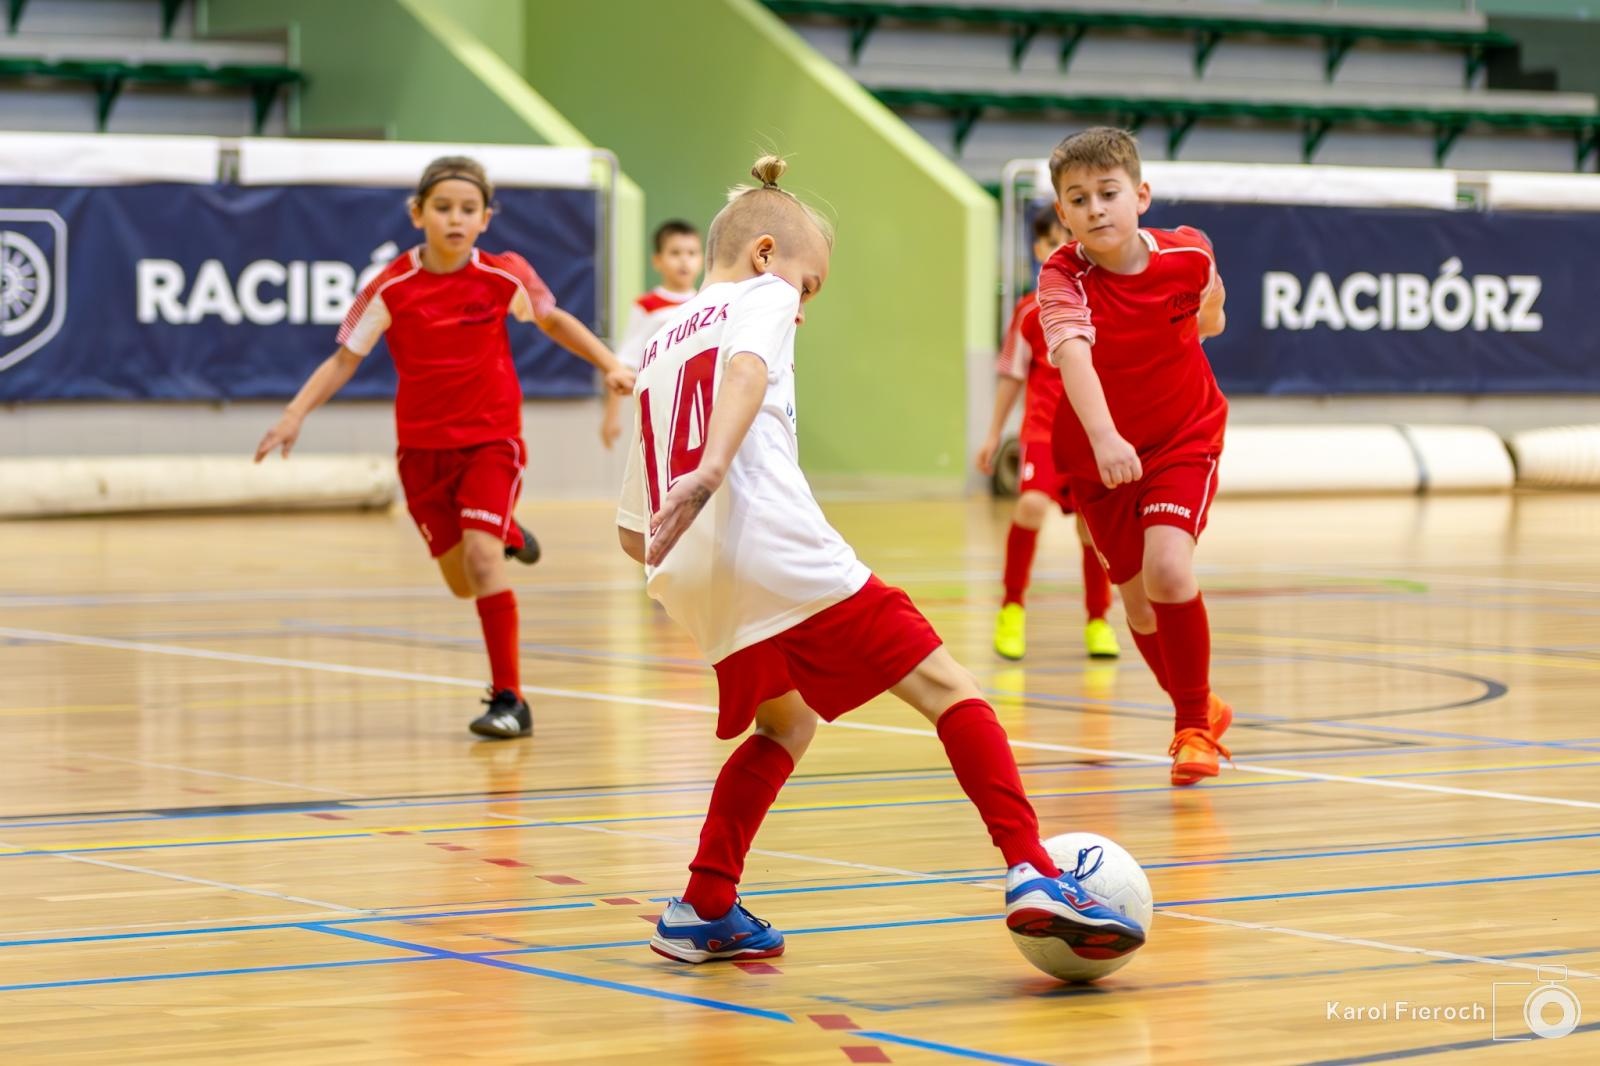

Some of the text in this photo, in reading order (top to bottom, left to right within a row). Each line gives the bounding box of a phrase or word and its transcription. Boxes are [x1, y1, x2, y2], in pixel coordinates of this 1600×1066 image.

[1262, 256, 1543, 332] RACIBÓRZ
[638, 340, 658, 373] IA
[639, 346, 719, 537] 14
[1148, 502, 1191, 519] PATRICK
